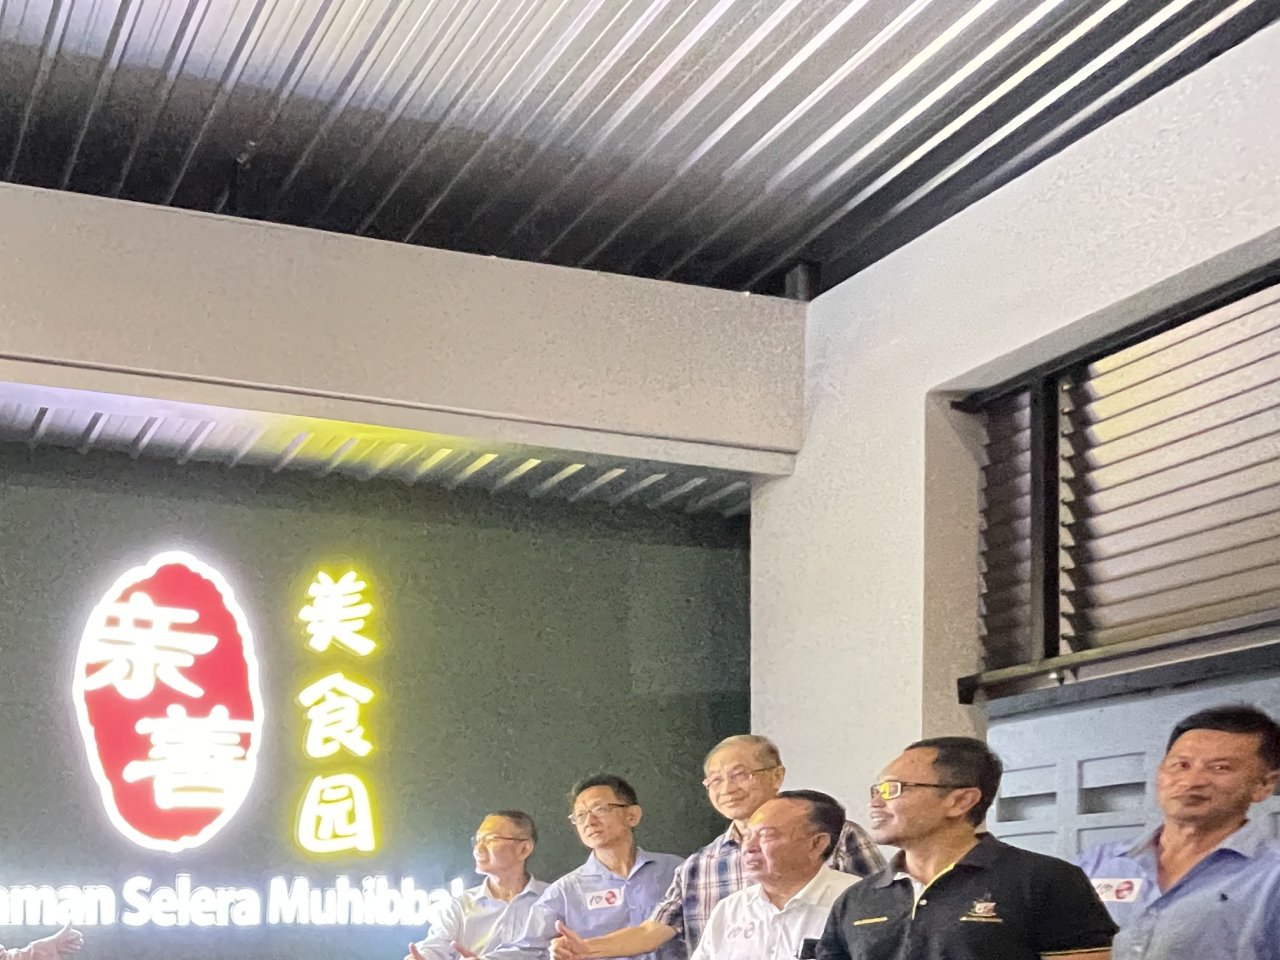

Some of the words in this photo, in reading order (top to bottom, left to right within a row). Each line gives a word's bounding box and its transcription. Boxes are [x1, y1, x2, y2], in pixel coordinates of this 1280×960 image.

[299, 570, 376, 853] 美食园
[122, 874, 261, 926] Selera
[269, 875, 464, 926] Muhibba
